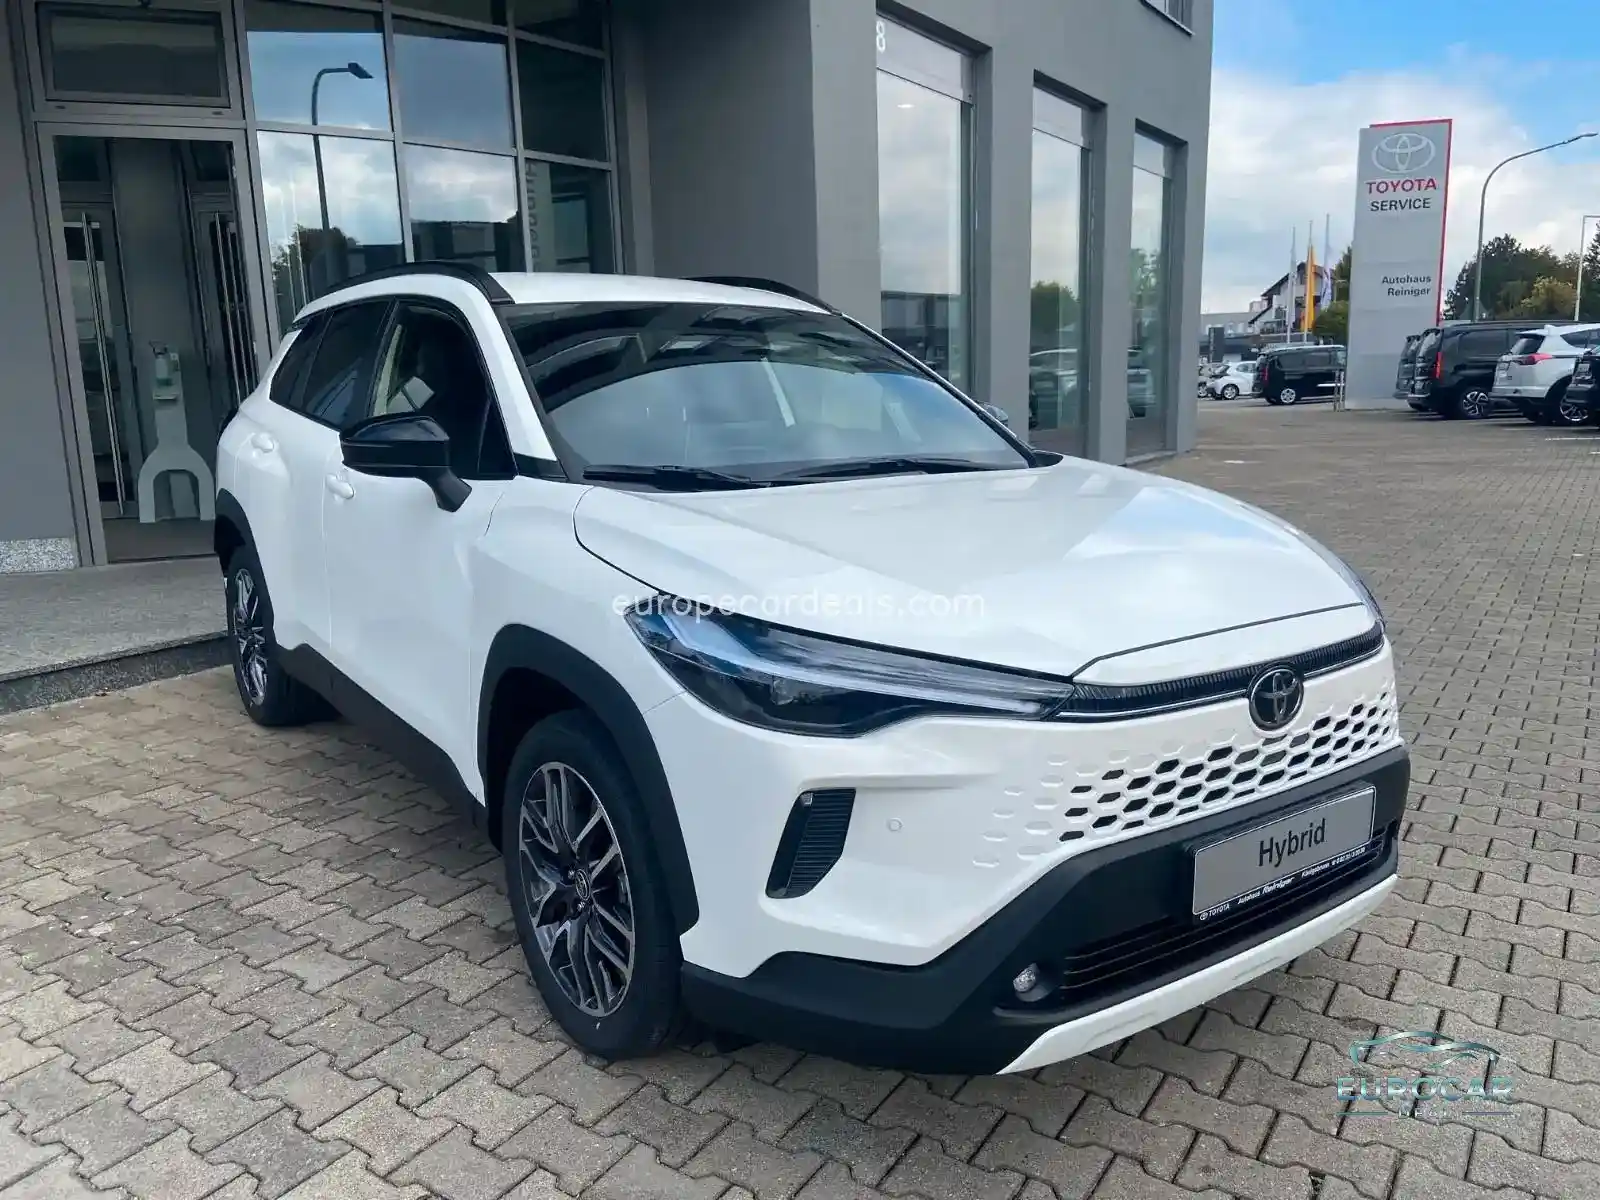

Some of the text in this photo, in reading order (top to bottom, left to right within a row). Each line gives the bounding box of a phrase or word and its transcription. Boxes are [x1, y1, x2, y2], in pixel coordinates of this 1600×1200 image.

[1366, 178, 1437, 194] TOYOTA
[1370, 198, 1431, 212] SERVICE
[1381, 273, 1432, 284] Autohaus
[1387, 287, 1431, 297] Reiniger
[1258, 817, 1327, 868] Hybrid
[1208, 904, 1230, 917] TOYOTA
